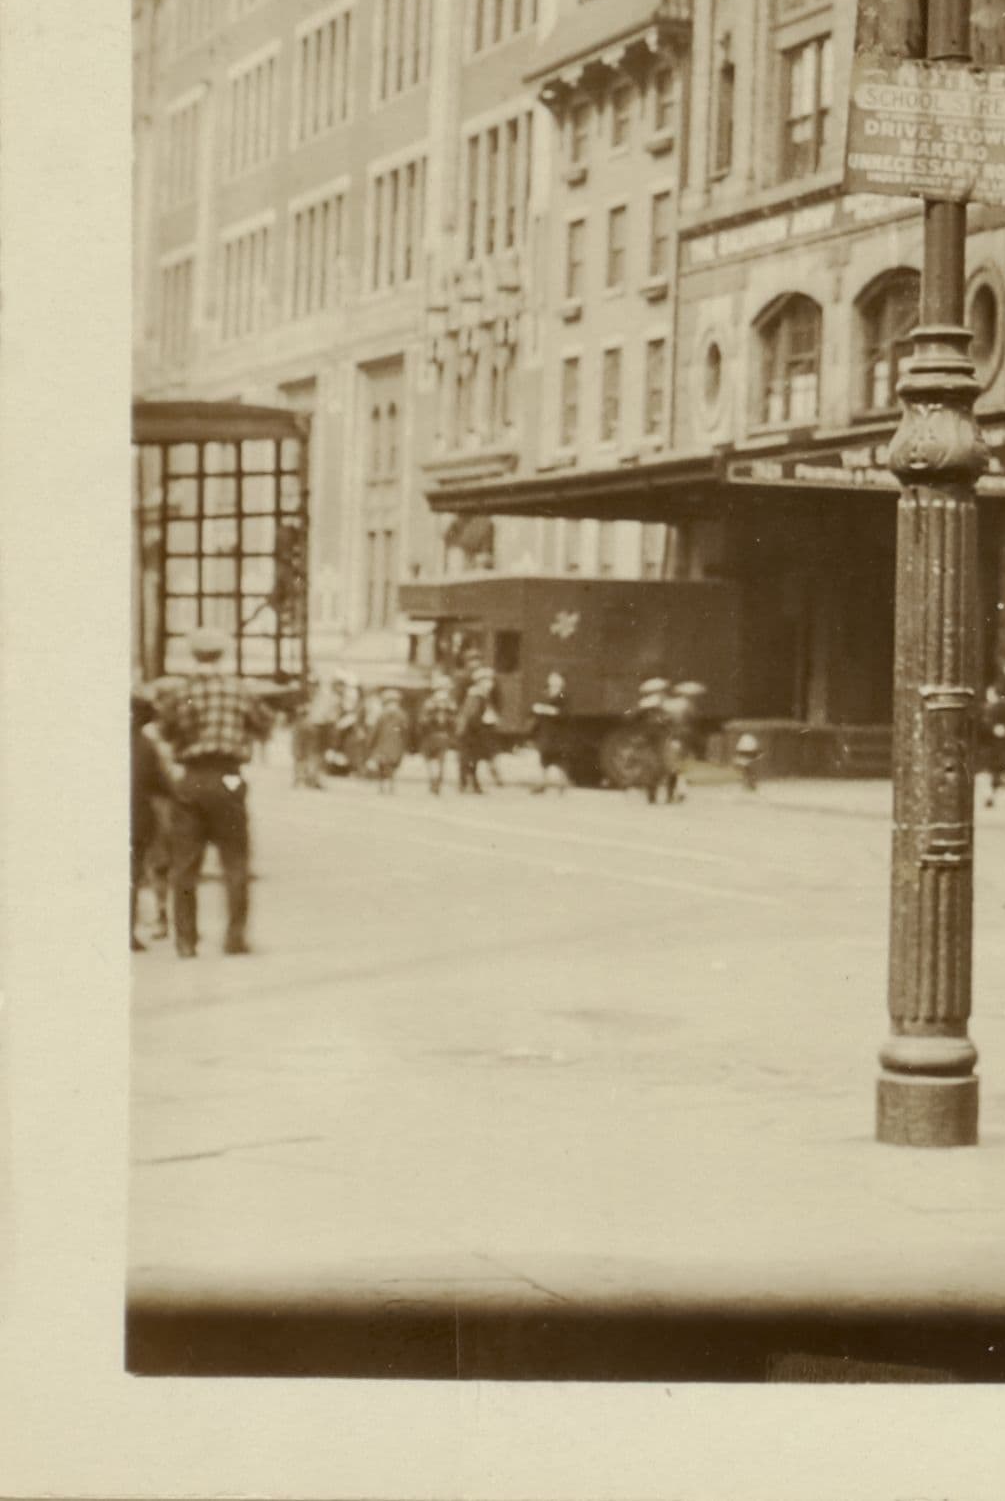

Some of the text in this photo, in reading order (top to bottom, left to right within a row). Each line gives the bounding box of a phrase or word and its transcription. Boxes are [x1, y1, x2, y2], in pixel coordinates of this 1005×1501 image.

[866, 88, 944, 112] SCHOOL
[863, 119, 933, 140] DRIVE
[899, 139, 959, 159] MAKE
